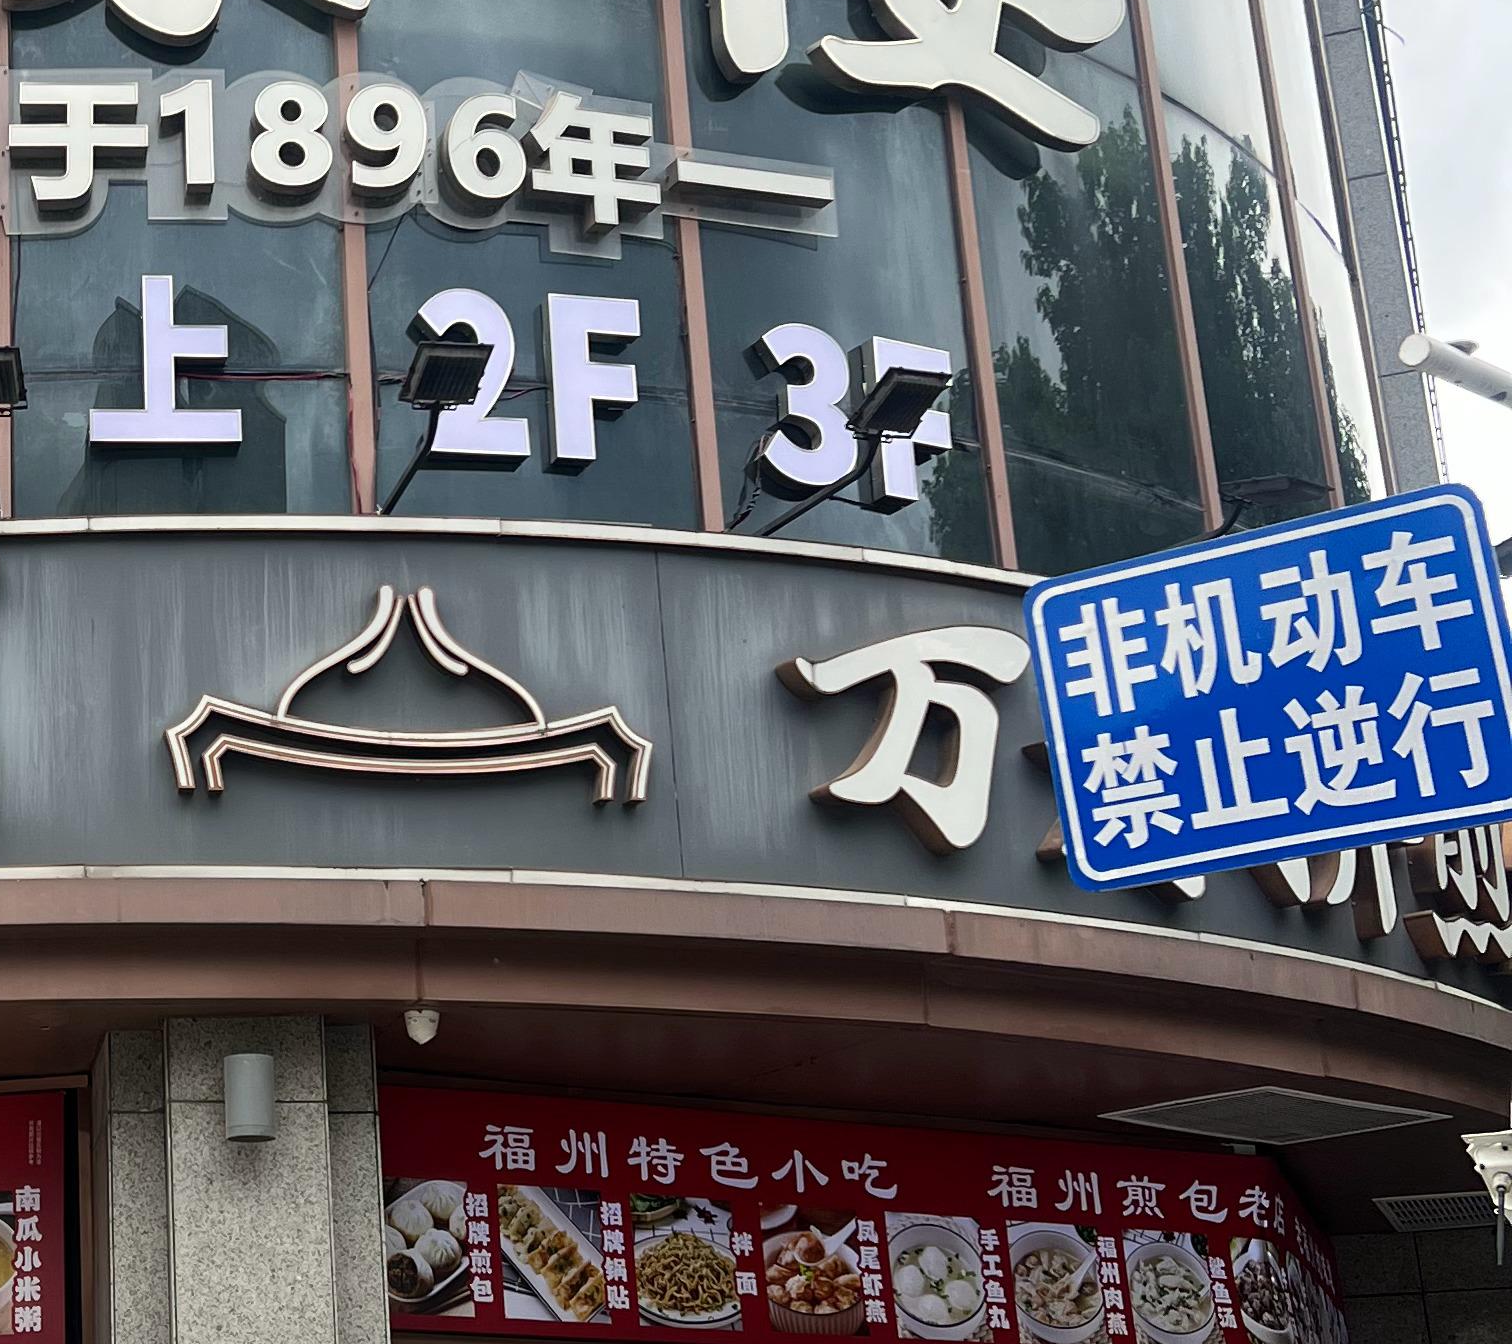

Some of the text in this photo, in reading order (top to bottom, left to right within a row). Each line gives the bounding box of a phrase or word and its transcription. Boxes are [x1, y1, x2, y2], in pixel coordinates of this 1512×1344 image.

[1056, 531, 1476, 719] 非机动车
[1081, 666, 1496, 851] 禁止逆行
[478, 1124, 897, 1199] 福州特色小吃
[987, 1165, 1286, 1236] 福州煎包老店
[14, 1185, 43, 1333] 南瓜小米粥
[466, 1192, 494, 1304] 招牌煎包
[600, 1201, 630, 1311] 招牌锅贴
[731, 1232, 759, 1297] 拌面
[856, 1219, 888, 1324] 凤尾虾燕
[979, 1229, 1011, 1330] 手工鱼丸
[1096, 1236, 1128, 1337] 福州肉燕
